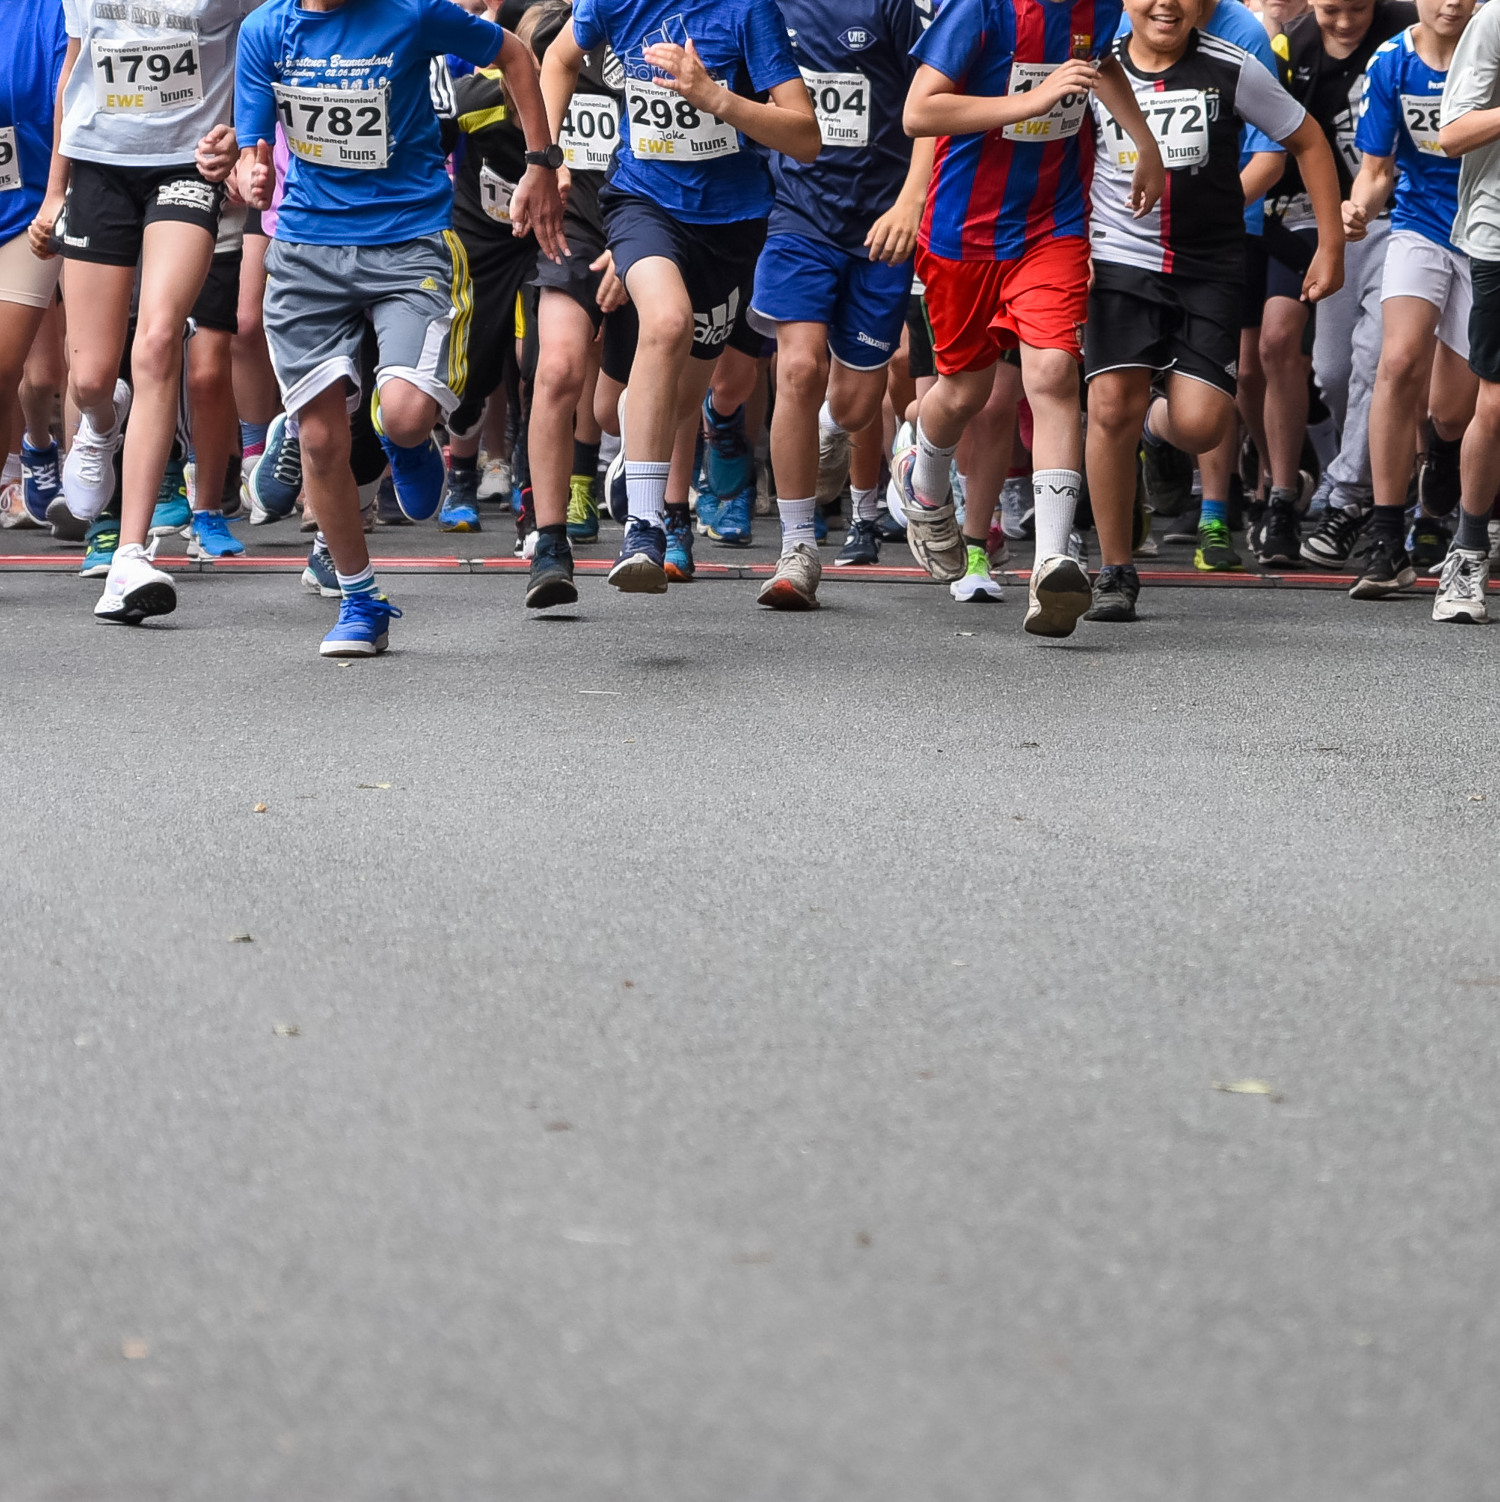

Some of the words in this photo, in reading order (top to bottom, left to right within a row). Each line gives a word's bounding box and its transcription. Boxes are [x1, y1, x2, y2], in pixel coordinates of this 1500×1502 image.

[97, 46, 140, 54] Everstener
[142, 41, 192, 52] Brunnenlauf
[96, 48, 198, 84] 1794
[329, 52, 394, 68] Brunnenlauf
[137, 85, 158, 93] Finja
[817, 78, 864, 86] Brunnenlauf
[107, 94, 144, 107] EWE
[160, 88, 194, 103] bruns
[276, 90, 321, 103] Everstener
[323, 96, 378, 104] Brunnenlauf
[630, 85, 667, 97] Everstener
[573, 100, 611, 109] Brunnenlauf
[1150, 96, 1198, 106] Brunnenlauf
[278, 100, 382, 137] 1782
[629, 95, 724, 130] 298
[1013, 120, 1052, 135] EWE
[1060, 116, 1081, 131] bruns
[1106, 104, 1204, 141] 172
[827, 124, 859, 139] bruns
[306, 134, 348, 145] Mohamed
[565, 139, 590, 147] Thomas
[638, 137, 675, 154] EWE
[689, 136, 728, 152] bruns
[1420, 139, 1442, 152] EW
[289, 136, 323, 158] EWE
[339, 146, 376, 160] bruns
[1118, 151, 1139, 165] EW
[1166, 146, 1201, 159] bruns
[586, 150, 611, 162] brun
[856, 332, 892, 351] SPALDING
